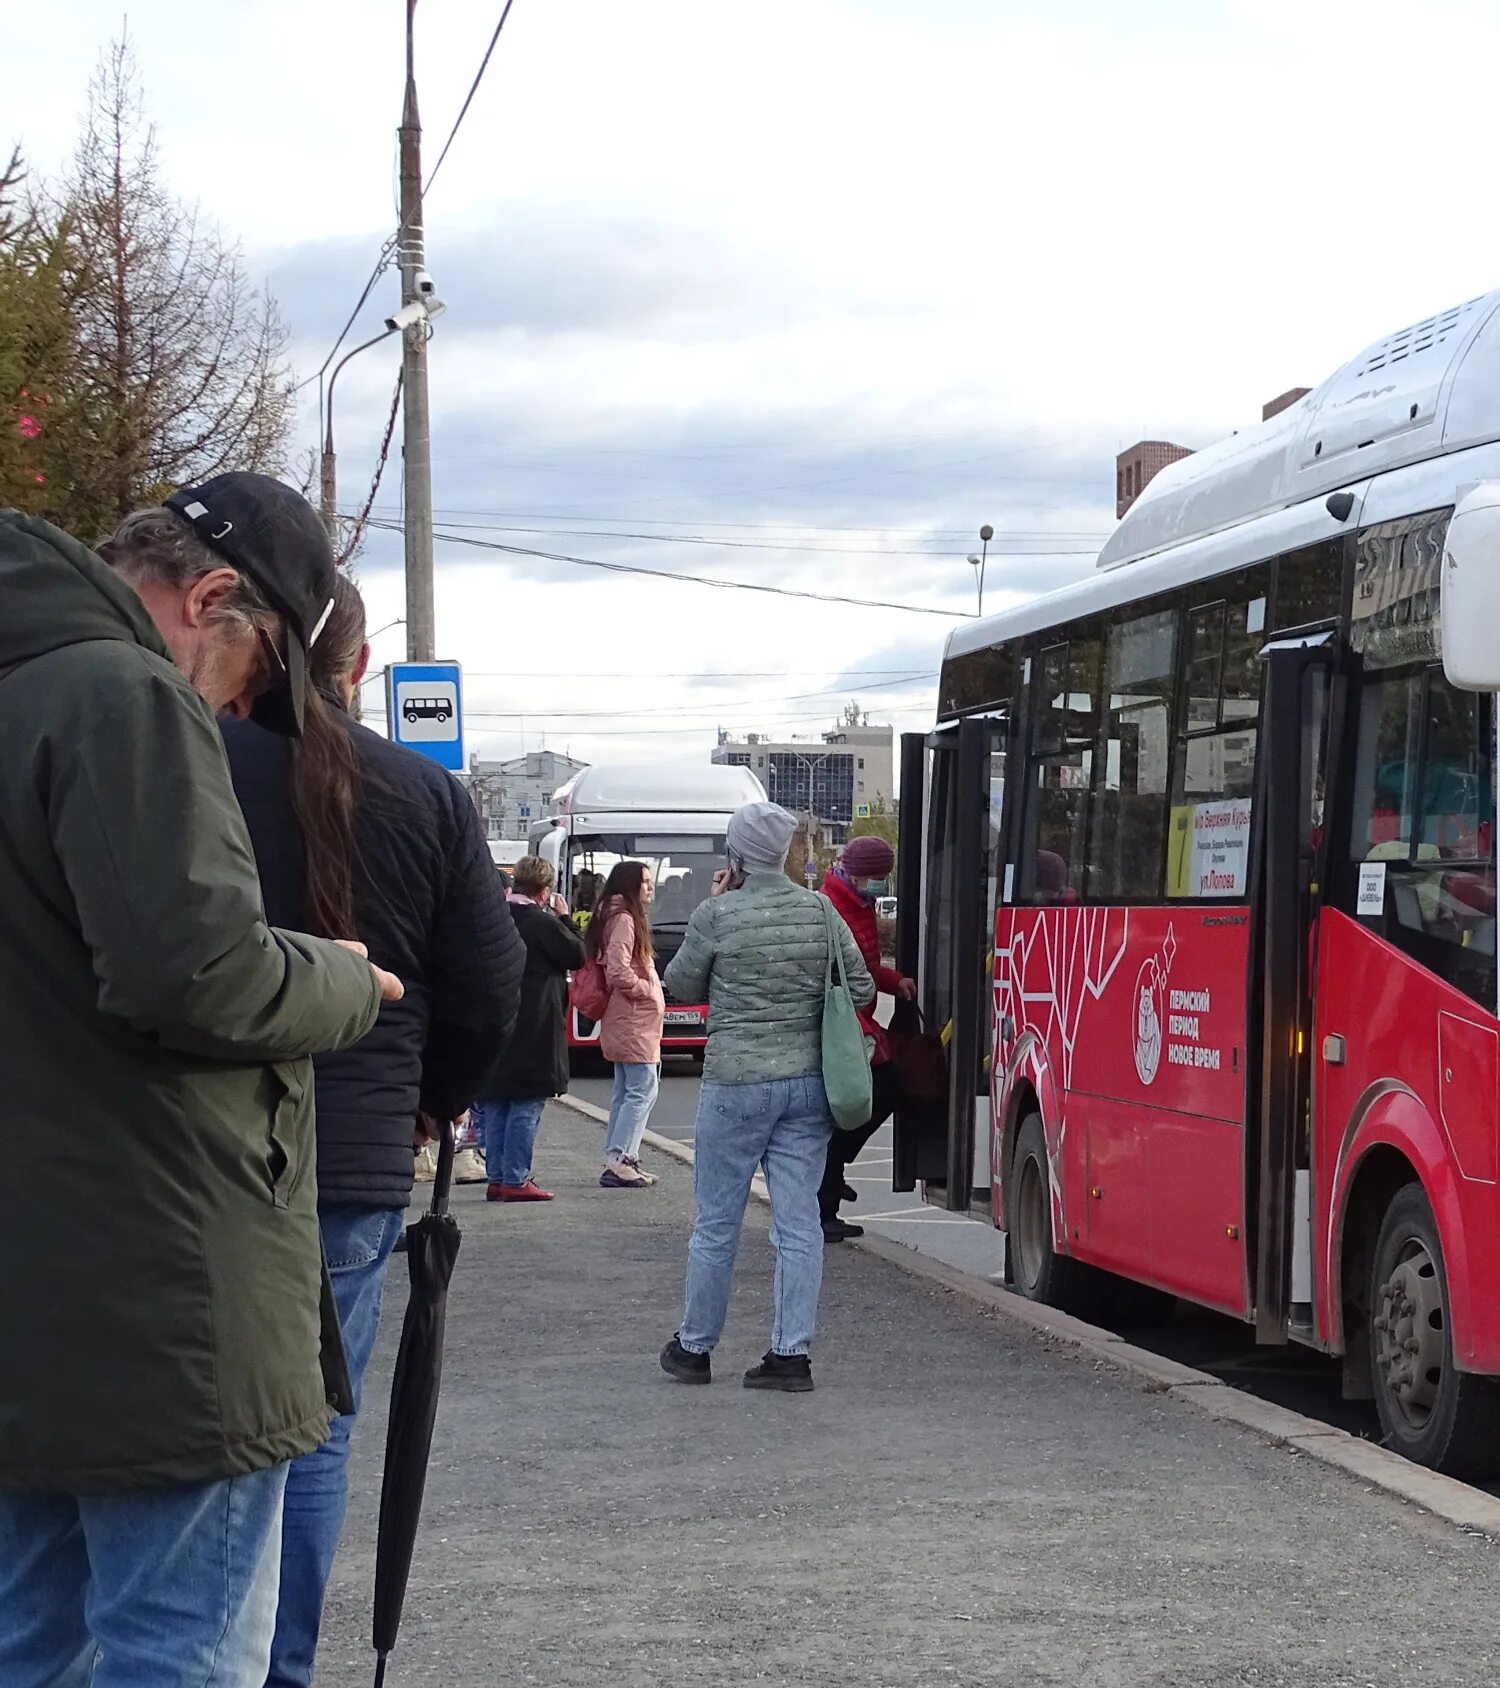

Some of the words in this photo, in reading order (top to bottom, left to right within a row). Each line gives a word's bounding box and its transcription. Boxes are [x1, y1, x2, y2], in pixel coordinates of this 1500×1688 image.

[1169, 987, 1210, 1013] ПЕРМСКИЙ
[1168, 1014, 1200, 1041] ПЕРИОД
[1168, 1043, 1194, 1066] НОВОЕ
[1194, 1046, 1220, 1070] ВРЕМЯ
